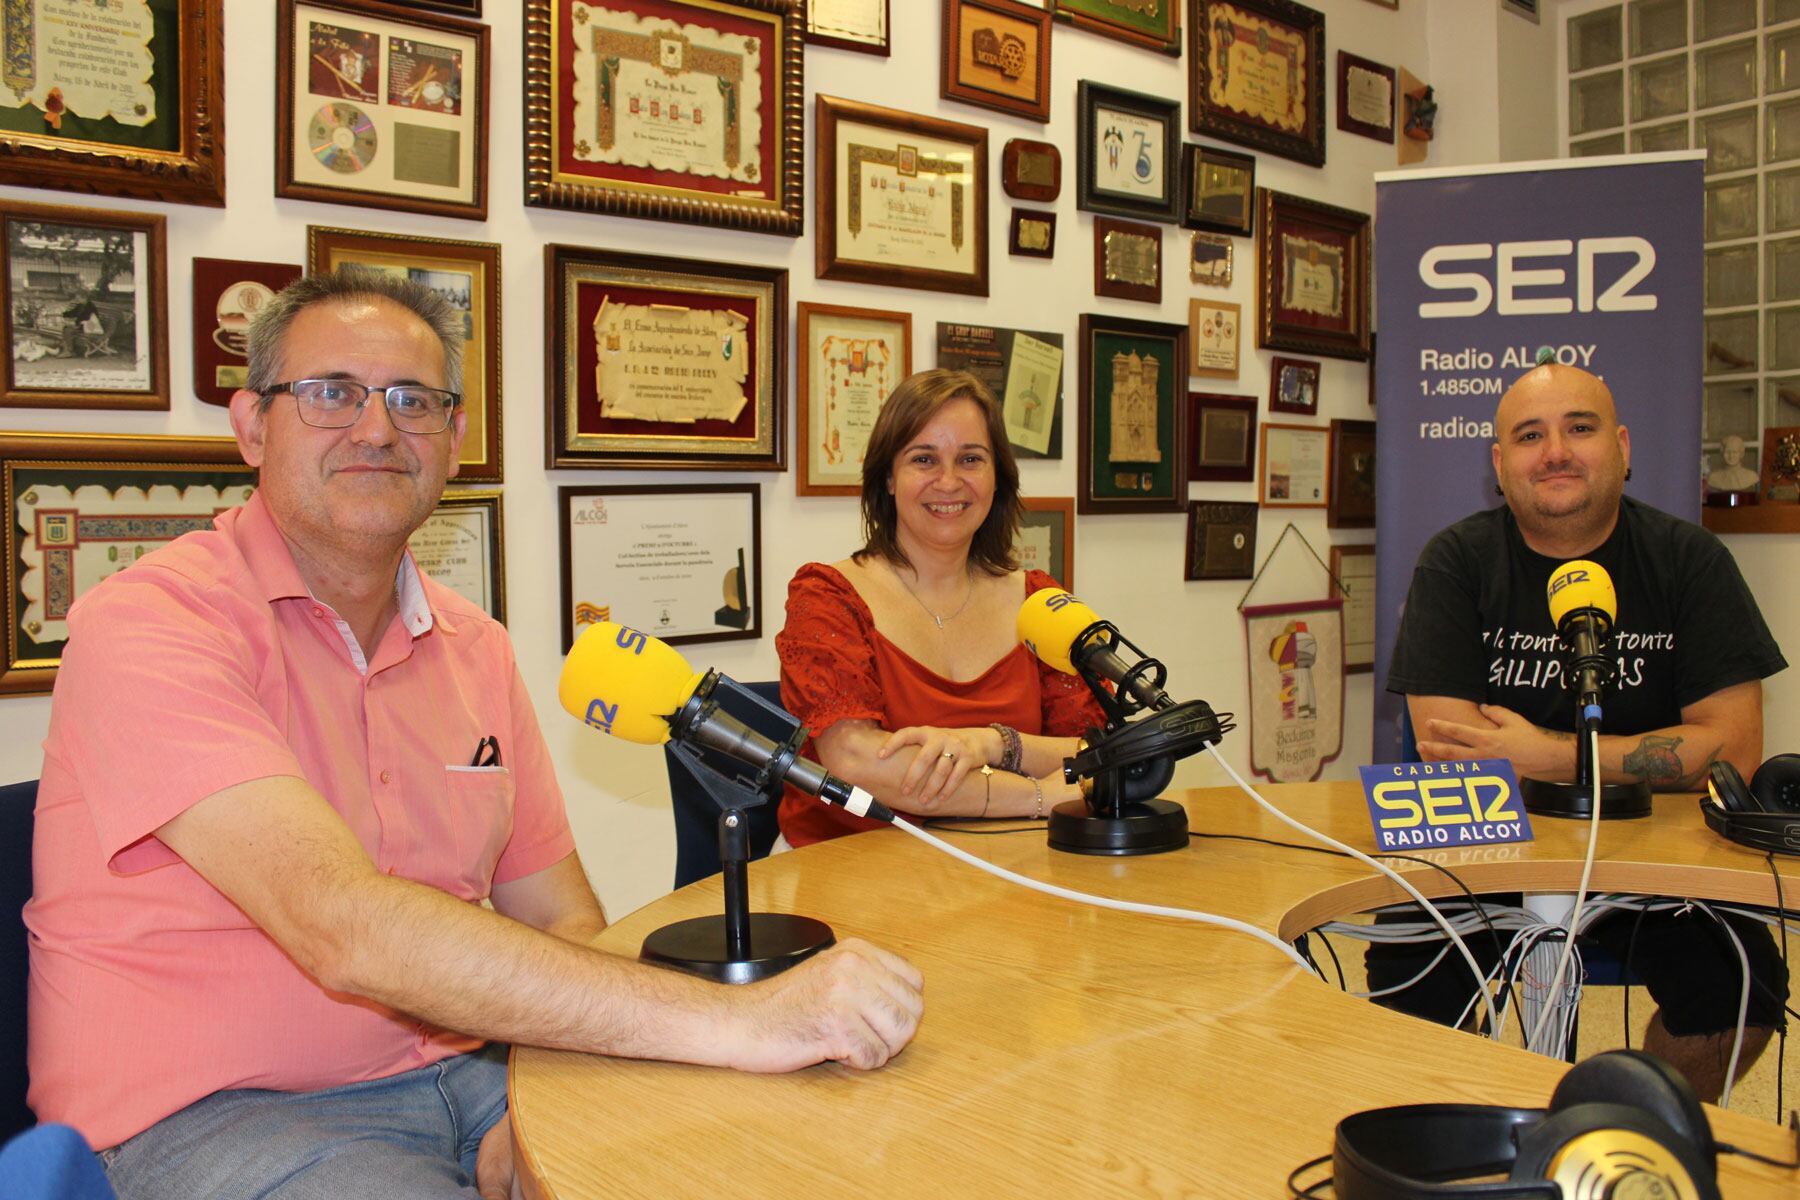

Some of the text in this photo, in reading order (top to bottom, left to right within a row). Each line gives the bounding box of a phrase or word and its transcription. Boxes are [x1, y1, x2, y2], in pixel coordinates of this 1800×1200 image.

[1419, 236, 1658, 319] SER
[1420, 348, 1494, 371] Radio
[1420, 416, 1498, 439] radioa
[1393, 762, 1481, 776] CADENA
[1372, 775, 1519, 829] SER
[1383, 823, 1522, 847] RADIO ALCOY
